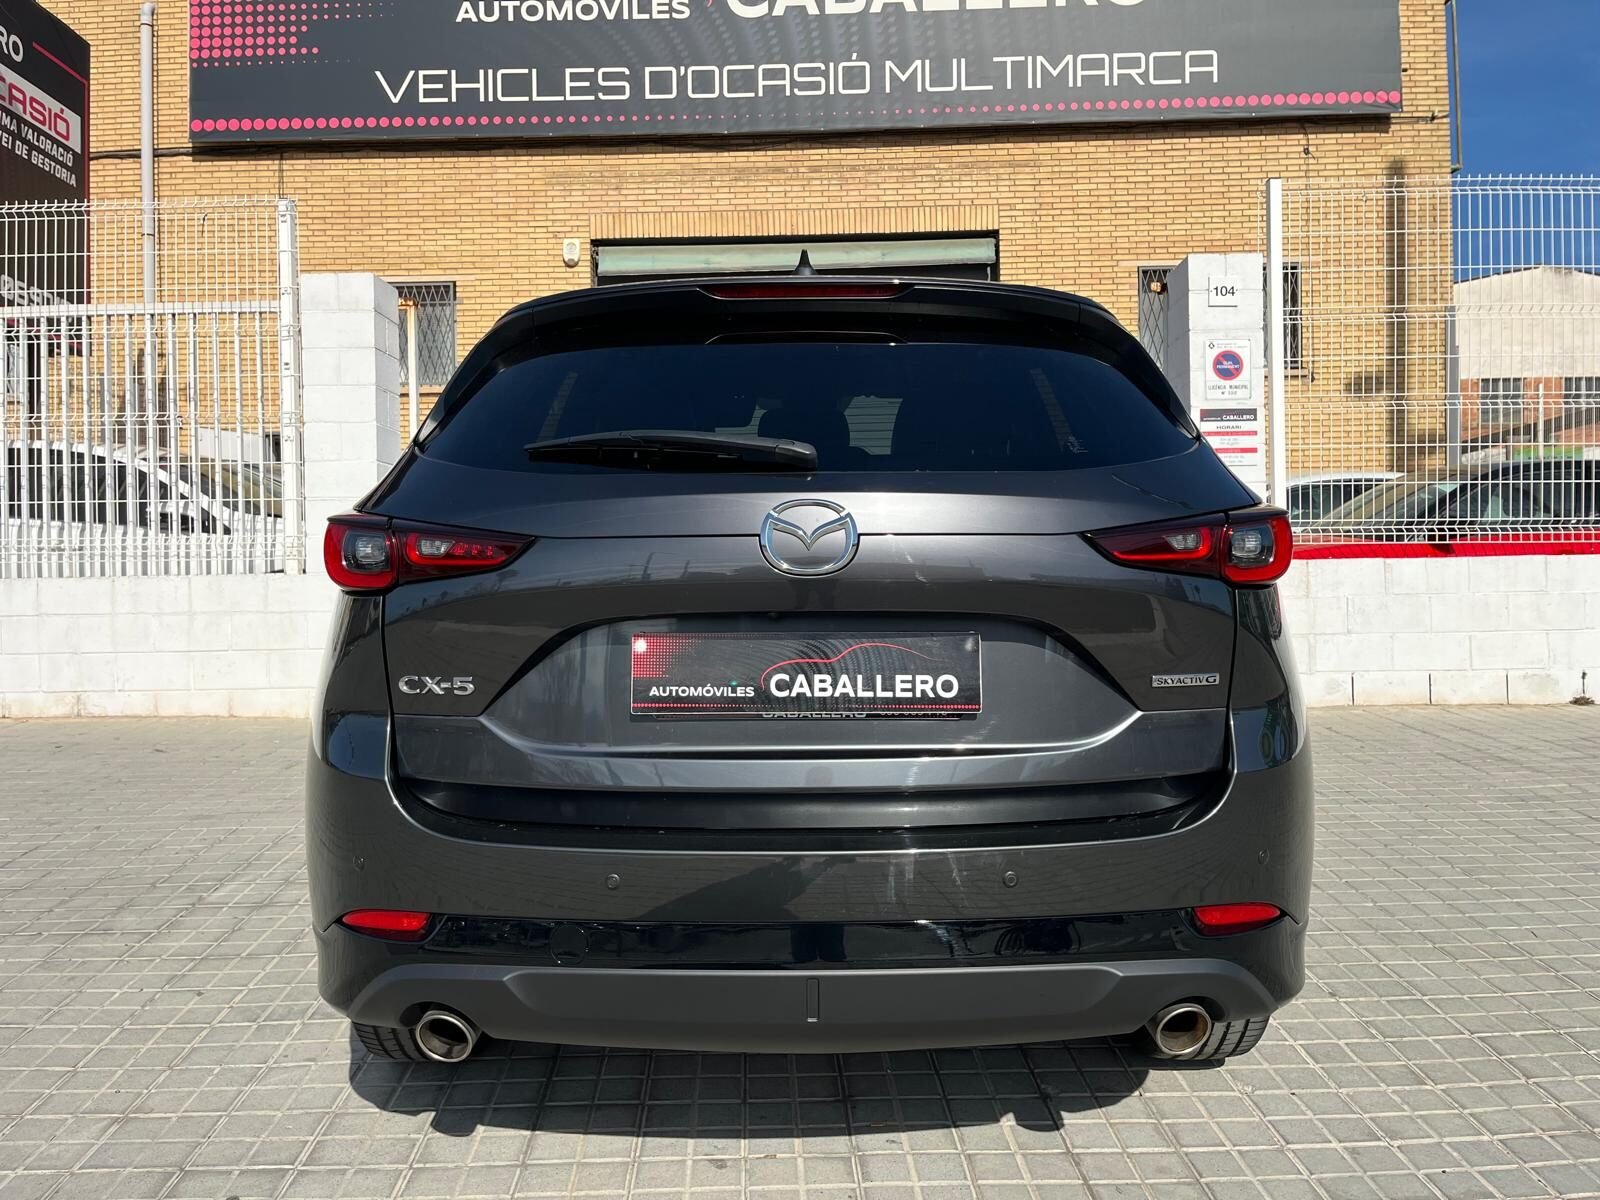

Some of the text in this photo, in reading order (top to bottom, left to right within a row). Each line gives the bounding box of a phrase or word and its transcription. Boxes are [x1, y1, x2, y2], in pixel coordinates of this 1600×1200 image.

[375, 49, 1219, 104] VEHICLES D'OCASIÓ MULTIMARCA
[21, 123, 73, 167] VALORACIÓ
[15, 140, 29, 160] DE
[31, 150, 77, 188] GESTORIA
[1213, 285, 1236, 297] 104
[398, 675, 475, 696] CX-5
[649, 673, 959, 698] AUTOMÓVILES CABALLERO
